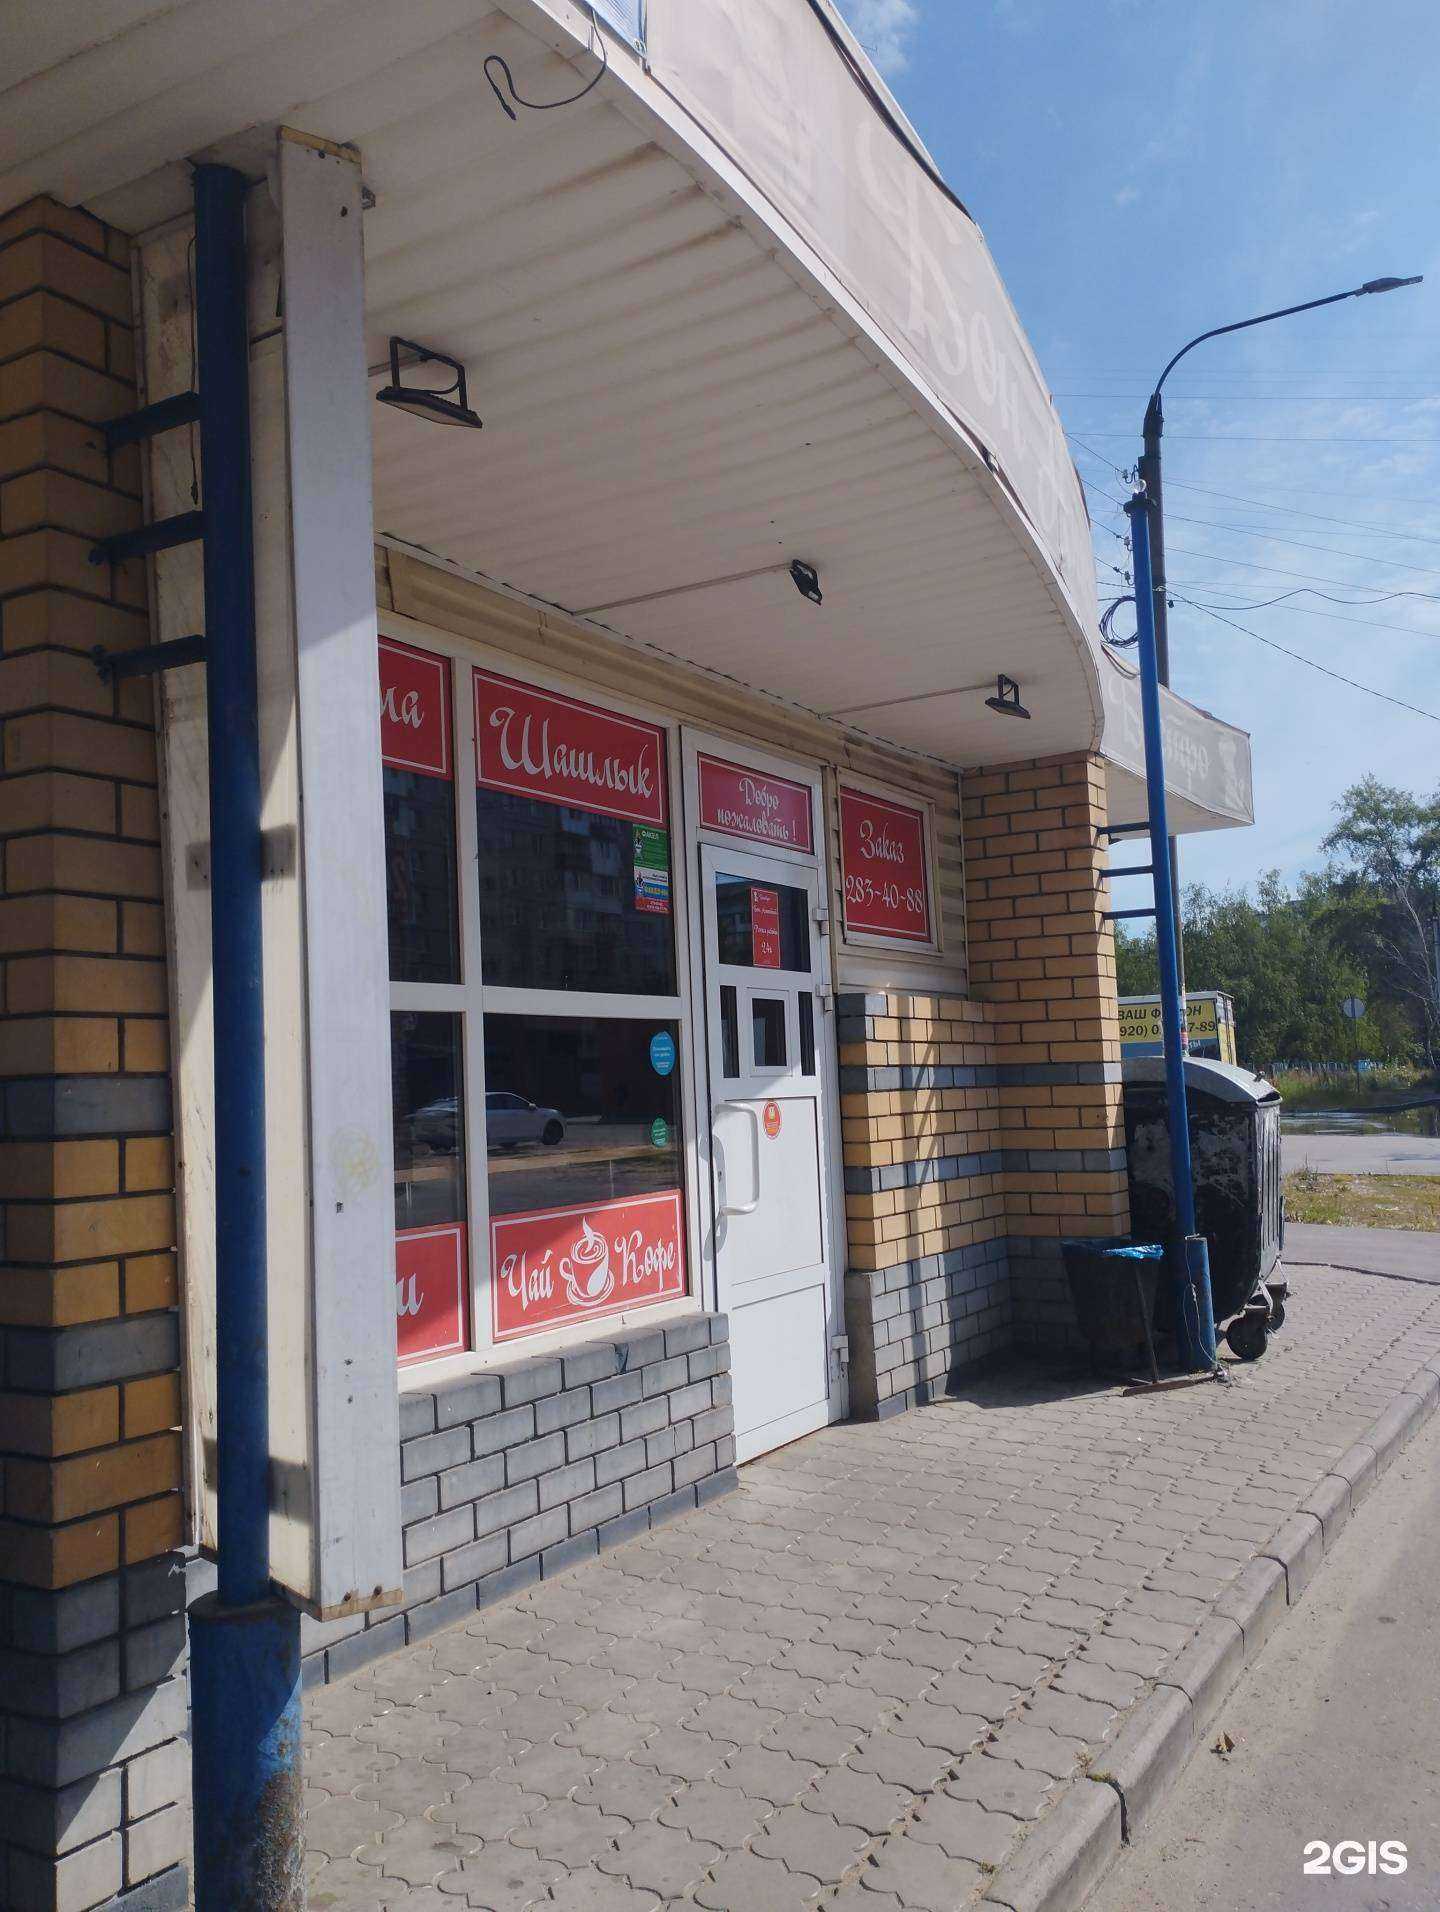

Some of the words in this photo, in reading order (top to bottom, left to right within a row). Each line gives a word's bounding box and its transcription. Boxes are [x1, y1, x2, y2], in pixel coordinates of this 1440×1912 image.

[489, 706, 654, 798] Шашлык
[739, 777, 780, 816] Добро
[859, 819, 905, 864] Заказ
[845, 874, 923, 913] 283-40-88
[1119, 1025, 1148, 1039] 920)
[501, 1250, 554, 1312] Чай
[614, 1229, 676, 1296] Кофе
